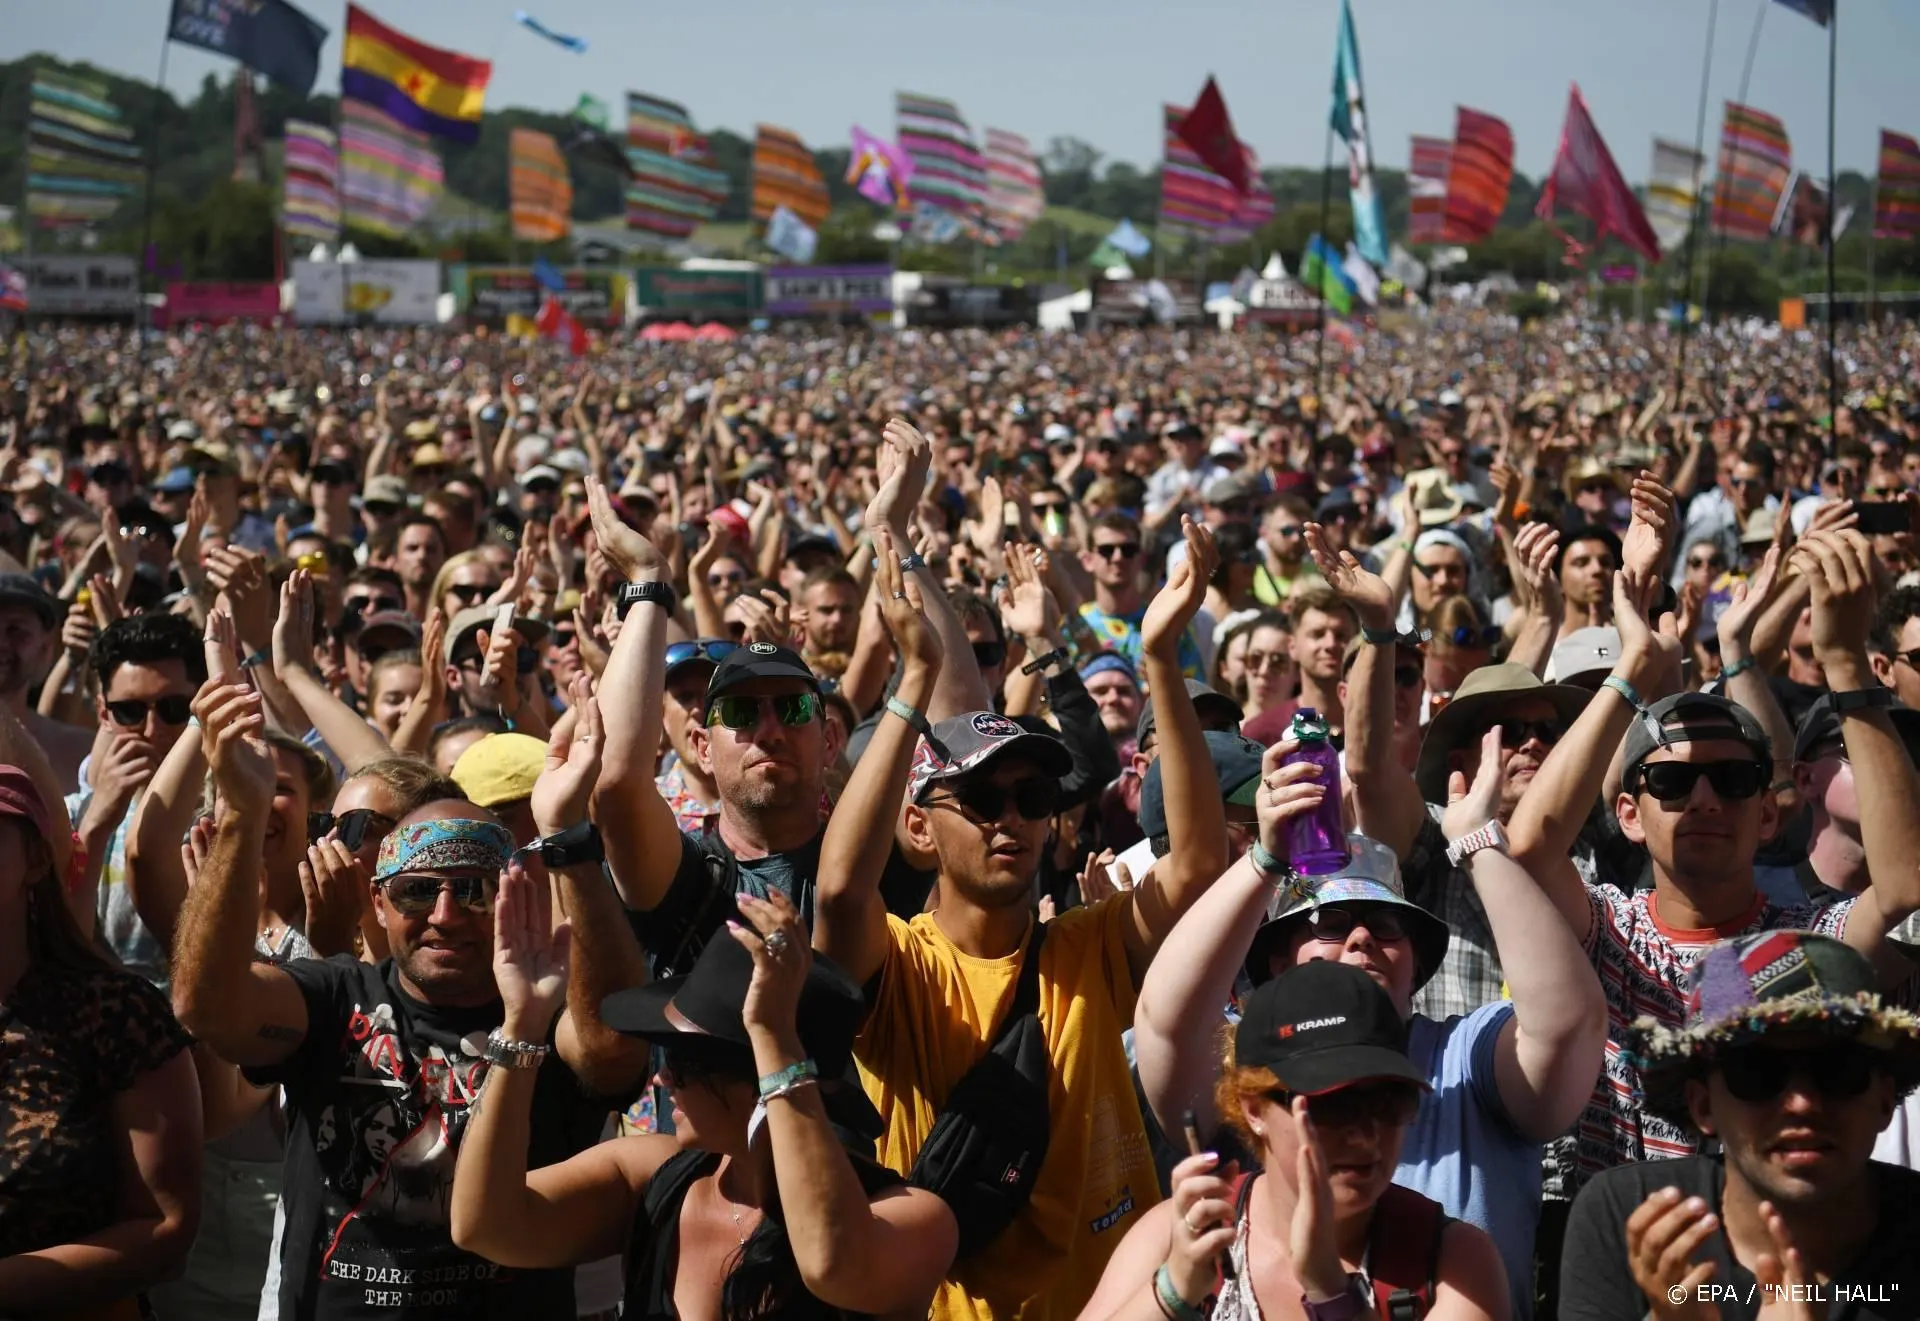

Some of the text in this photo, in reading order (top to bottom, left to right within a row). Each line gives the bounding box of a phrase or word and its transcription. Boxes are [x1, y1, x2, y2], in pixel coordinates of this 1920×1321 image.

[754, 643, 774, 652] Buff
[976, 720, 1016, 730] NASA
[1296, 1016, 1346, 1032] KRAMP
[331, 1260, 360, 1279] THE
[365, 1266, 415, 1284] DARK
[420, 1265, 468, 1283] SIDE
[365, 1288, 402, 1306] THE
